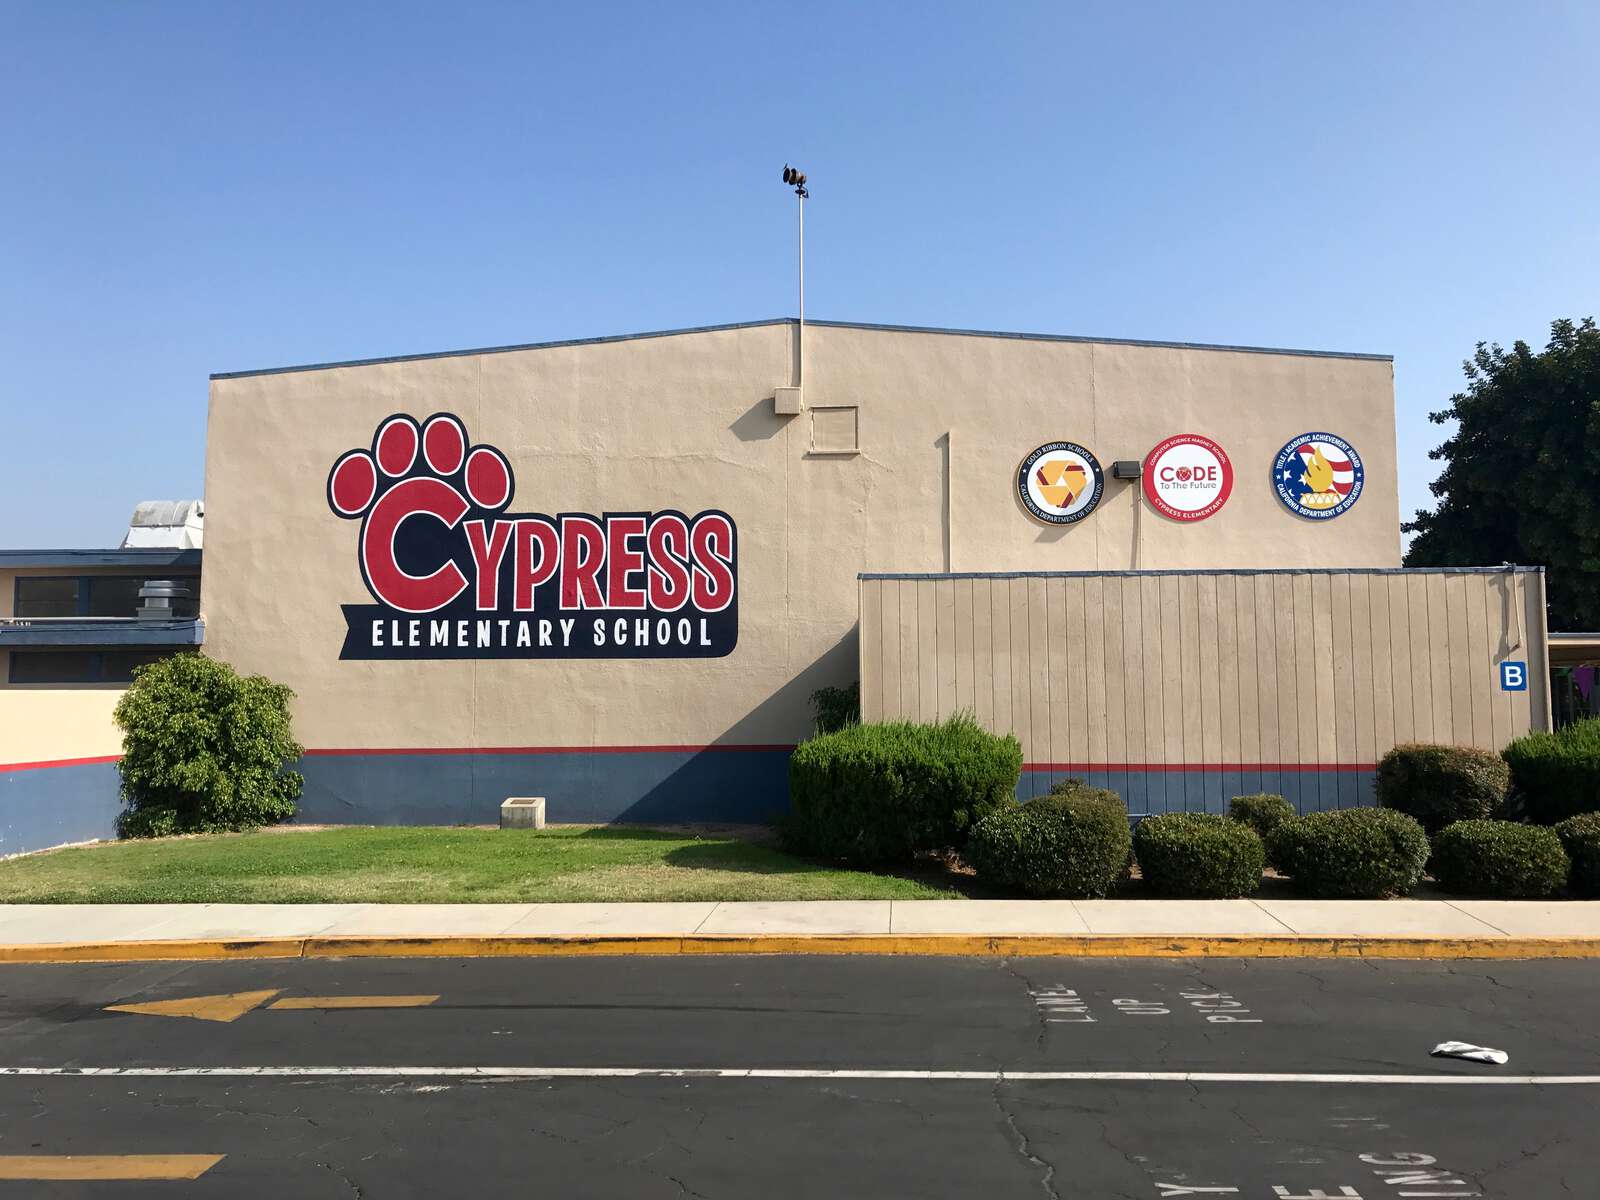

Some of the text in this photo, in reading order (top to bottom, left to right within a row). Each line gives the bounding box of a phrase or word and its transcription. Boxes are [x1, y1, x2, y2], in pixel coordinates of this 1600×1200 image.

[1027, 443, 1095, 465] GOLD RIBBON SCHOOLS
[1150, 444, 1170, 466] COMPUTER
[1170, 438, 1190, 446] SCIENCE
[1212, 446, 1226, 464] SCHOOL
[1276, 455, 1286, 469] TITLE
[1285, 435, 1311, 454] ACADEMIC
[1312, 434, 1350, 450] ACHIEVEMENT
[1347, 449, 1360, 468] AWARD
[1160, 482, 1170, 490] To
[1276, 484, 1300, 511] CALIFORNIA
[1299, 508, 1336, 518] DEPARTMENT
[1342, 481, 1362, 508] EDUCATION
[1020, 482, 1102, 522] CALIFORNIA DEPARTMENT OF EDUCATION
[1154, 497, 1223, 518] CYPRESS ELEMENTARY
[363, 476, 734, 613] CYPRESS
[371, 617, 713, 648] ELEMENTARY SCHOOL
[1504, 665, 1523, 687] B
